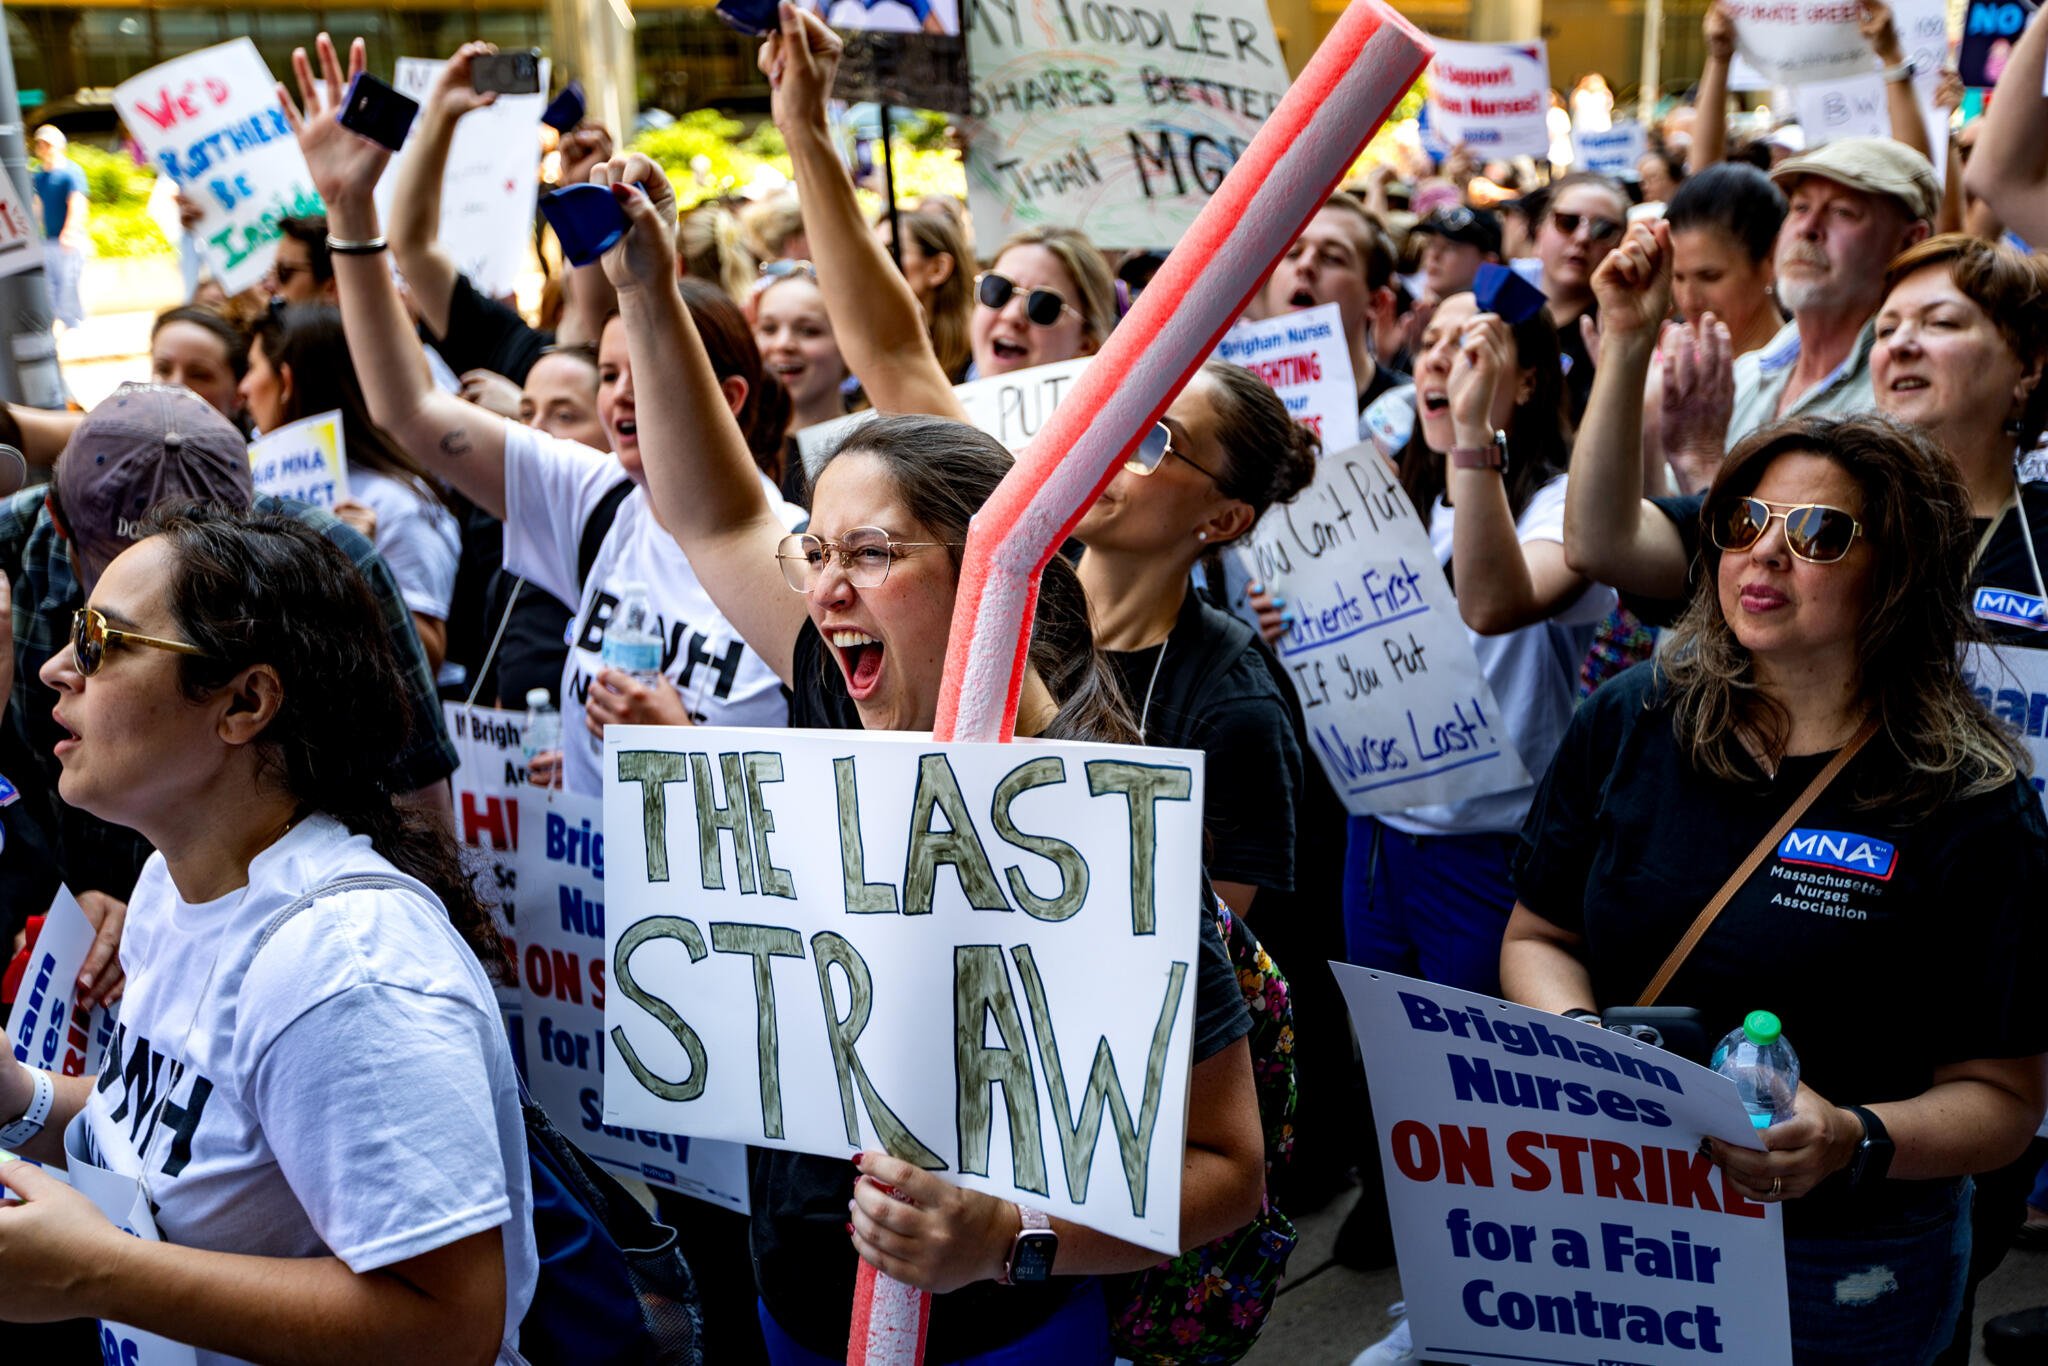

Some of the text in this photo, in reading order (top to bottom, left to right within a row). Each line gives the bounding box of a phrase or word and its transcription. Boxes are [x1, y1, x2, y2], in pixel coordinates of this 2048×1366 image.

[1969, 4, 2025, 36] NO
[210, 175, 253, 210] BE
[996, 144, 1102, 200] THAN
[1286, 322, 1332, 344] Nurses
[1245, 351, 1321, 389] GHTING
[1000, 375, 1071, 441] PUT
[1345, 459, 1408, 534] Put
[1362, 557, 1424, 618] First
[1294, 631, 1429, 708] If You Put
[471, 714, 521, 749] Brigh
[1314, 696, 1497, 787] Nurses Last!
[546, 811, 604, 880] Brig
[618, 750, 1194, 937] THE LAST
[1784, 831, 1883, 869] MNA
[1770, 865, 1884, 897] Massachusetts
[1770, 892, 1868, 921] Association
[1795, 883, 1850, 904] Nurses
[524, 943, 583, 1006] ON
[538, 1016, 590, 1071] for
[610, 915, 1189, 1219] STRAW
[1397, 991, 1686, 1096] Brigham
[1446, 1053, 1674, 1128] Nurses
[1390, 1119, 1495, 1188] ON
[1446, 1208, 1722, 1284] for a Fair
[1461, 1279, 1724, 1354] Contract
